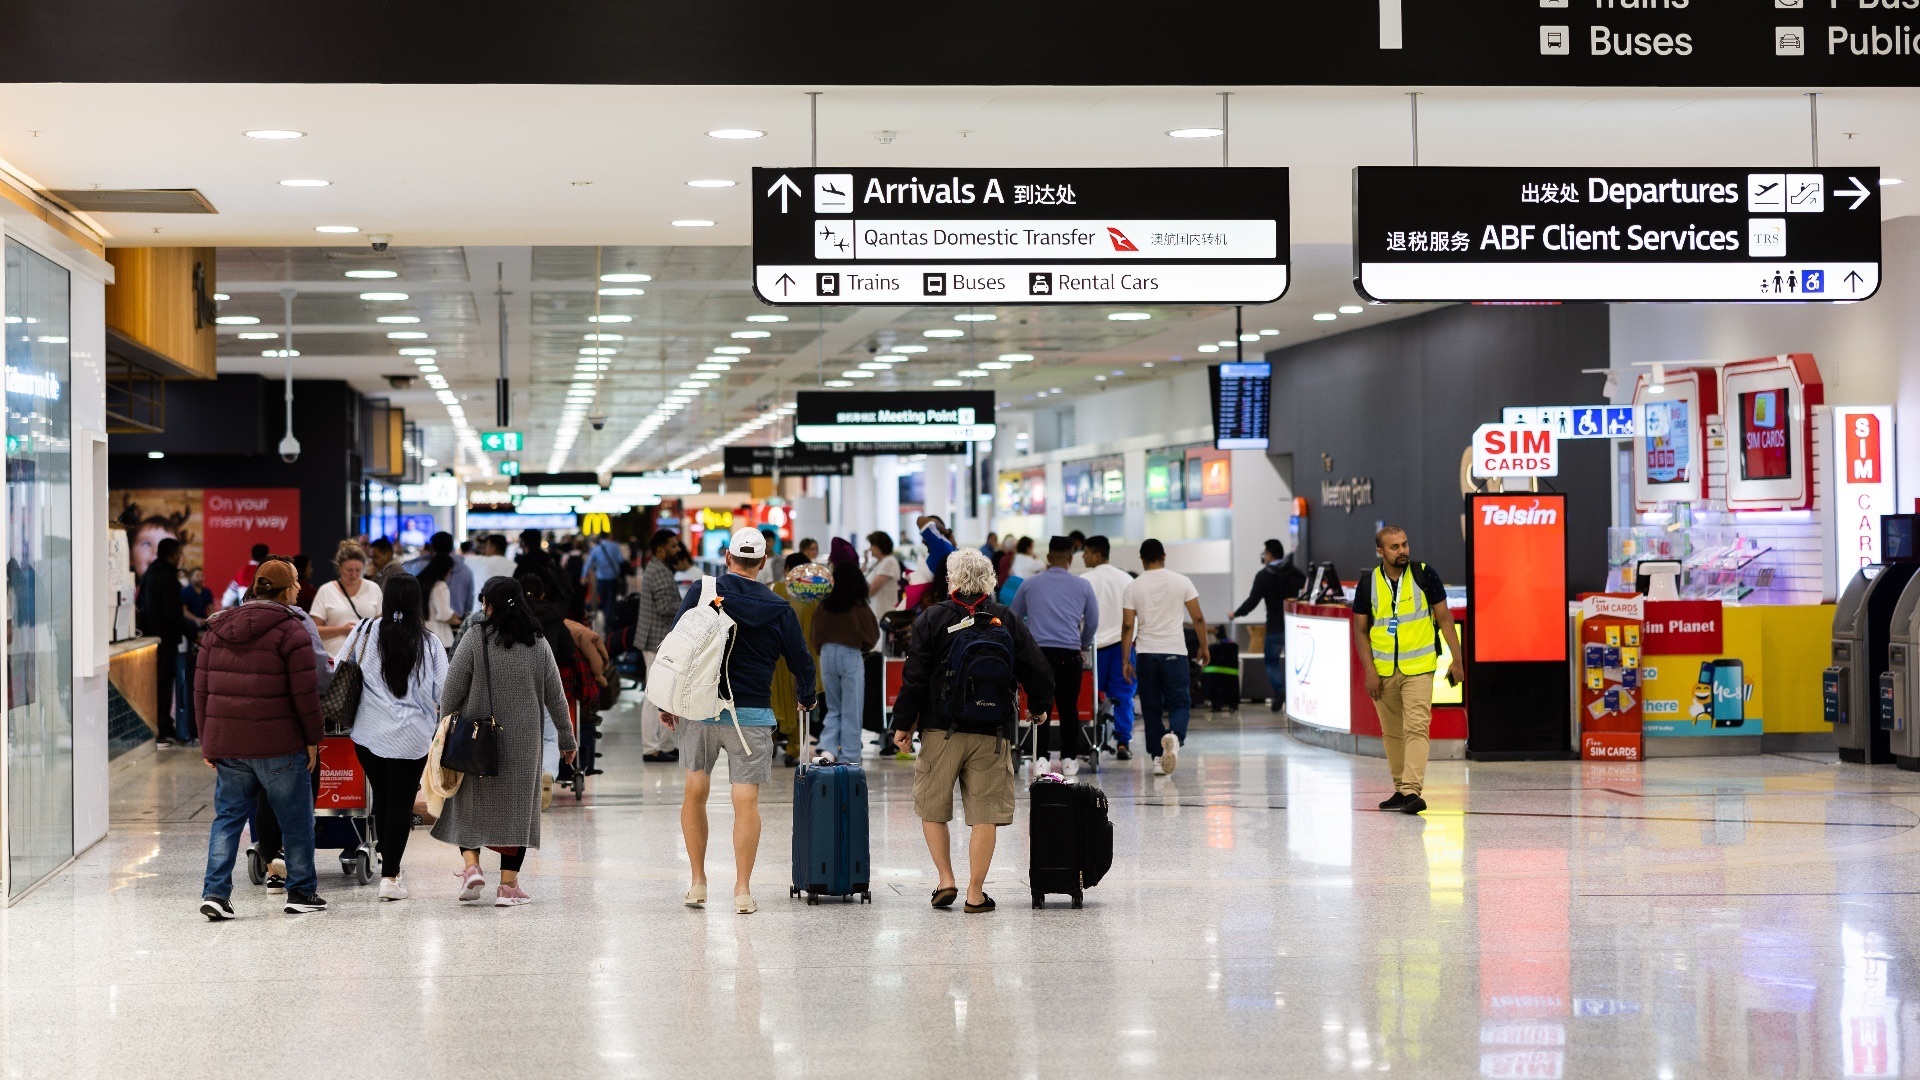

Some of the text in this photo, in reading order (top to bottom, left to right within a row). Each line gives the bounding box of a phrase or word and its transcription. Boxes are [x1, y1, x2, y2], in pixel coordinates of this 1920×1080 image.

[1591, 26, 1692, 55] Buses
[864, 177, 1076, 205] Arrivals A 到达处
[1522, 178, 1738, 209] 出发处 Departures
[865, 229, 1228, 248] Qantas Domestic Transfer 澳航国内转机
[1387, 224, 1739, 252] 退税服务 ABF Client Services
[1753, 233, 1779, 244] TRS
[847, 274, 900, 291] Trains
[953, 274, 1006, 290] Buses
[1059, 274, 1159, 291] Rental Cars
[878, 409, 926, 425] Meeting
[927, 409, 957, 423] Point
[1485, 430, 1551, 454] SIM
[1746, 428, 1786, 449] SIM CARDS
[1853, 417, 1873, 479] SIM
[1485, 457, 1551, 471] CARDS
[209, 496, 270, 514] On your
[1481, 500, 1557, 526] Telsim
[209, 515, 289, 531] merry way
[1595, 604, 1638, 613] SIM CARDS
[1669, 620, 1716, 634] Planet
[1642, 699, 1678, 712] here
[1590, 747, 1637, 757] SIM CARDS
[320, 769, 353, 777] ROAMING
